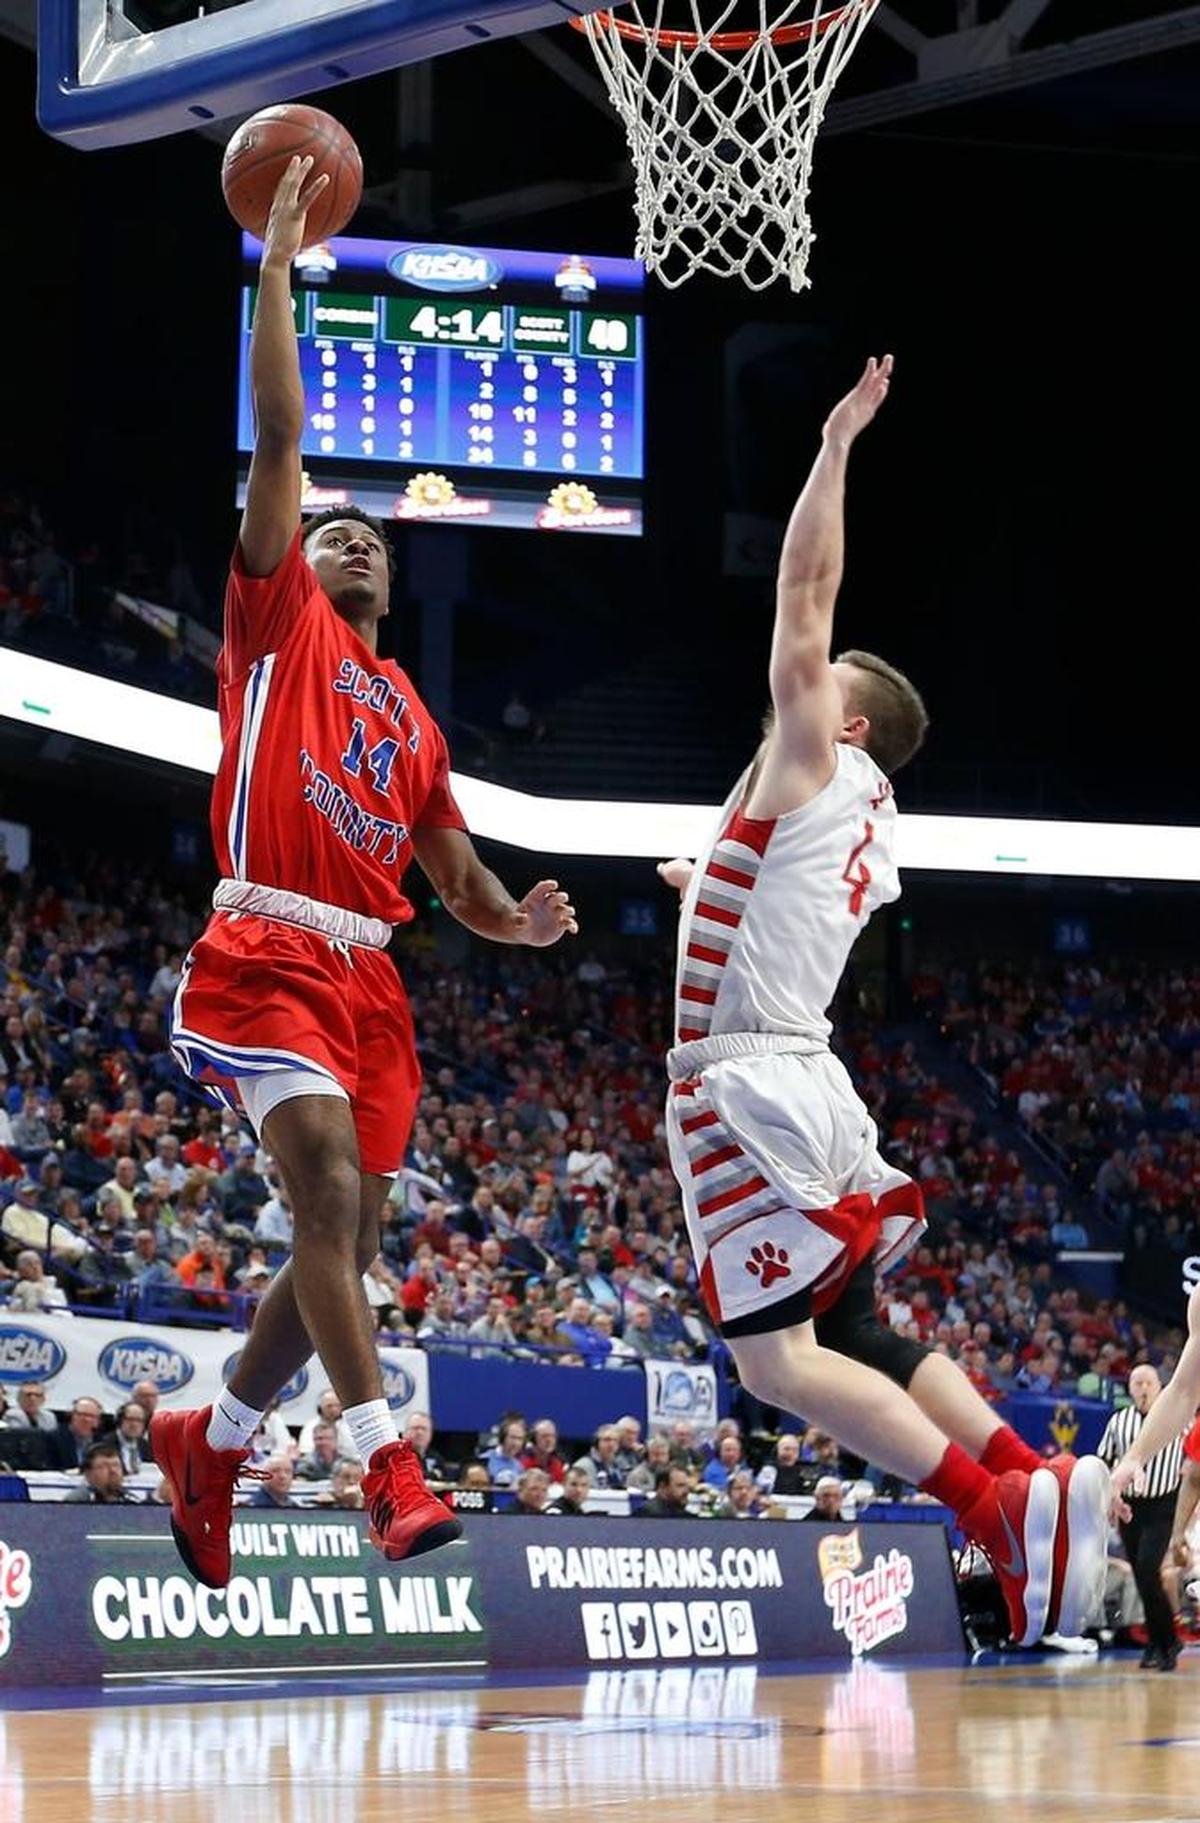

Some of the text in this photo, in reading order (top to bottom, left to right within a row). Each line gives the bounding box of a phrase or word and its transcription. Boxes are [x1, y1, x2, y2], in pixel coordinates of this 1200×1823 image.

[401, 252, 488, 282] KHSAA
[410, 307, 504, 343] 4:14
[363, 352, 375, 369] 1
[400, 355, 412, 371] 1
[480, 362, 492, 377] 1
[563, 367, 577, 383] 3
[601, 370, 613, 386] 1
[363, 374, 376, 390] 3
[400, 377, 412, 392] 1
[480, 382, 493, 399] 2
[600, 391, 613, 407] 1
[362, 395, 375, 411] 1
[400, 420, 412, 436] 1
[513, 406, 536, 423] 11
[600, 412, 614, 429] 2
[361, 439, 374, 455] 1
[399, 441, 413, 458] 2
[523, 429, 537, 446] 3
[600, 434, 613, 451] 1
[600, 455, 613, 473] 2
[340, 717, 401, 800] 14
[842, 819, 873, 917] 4
[0, 1335, 52, 1372] HSAA
[108, 1345, 183, 1383] KHSAA
[230, 1523, 361, 1557] UILT WITH
[525, 1545, 784, 1590] PRAIRIEFARMS.COM
[825, 1551, 912, 1629] Prairie
[92, 1575, 483, 1641] CHOCOLATE MILK
